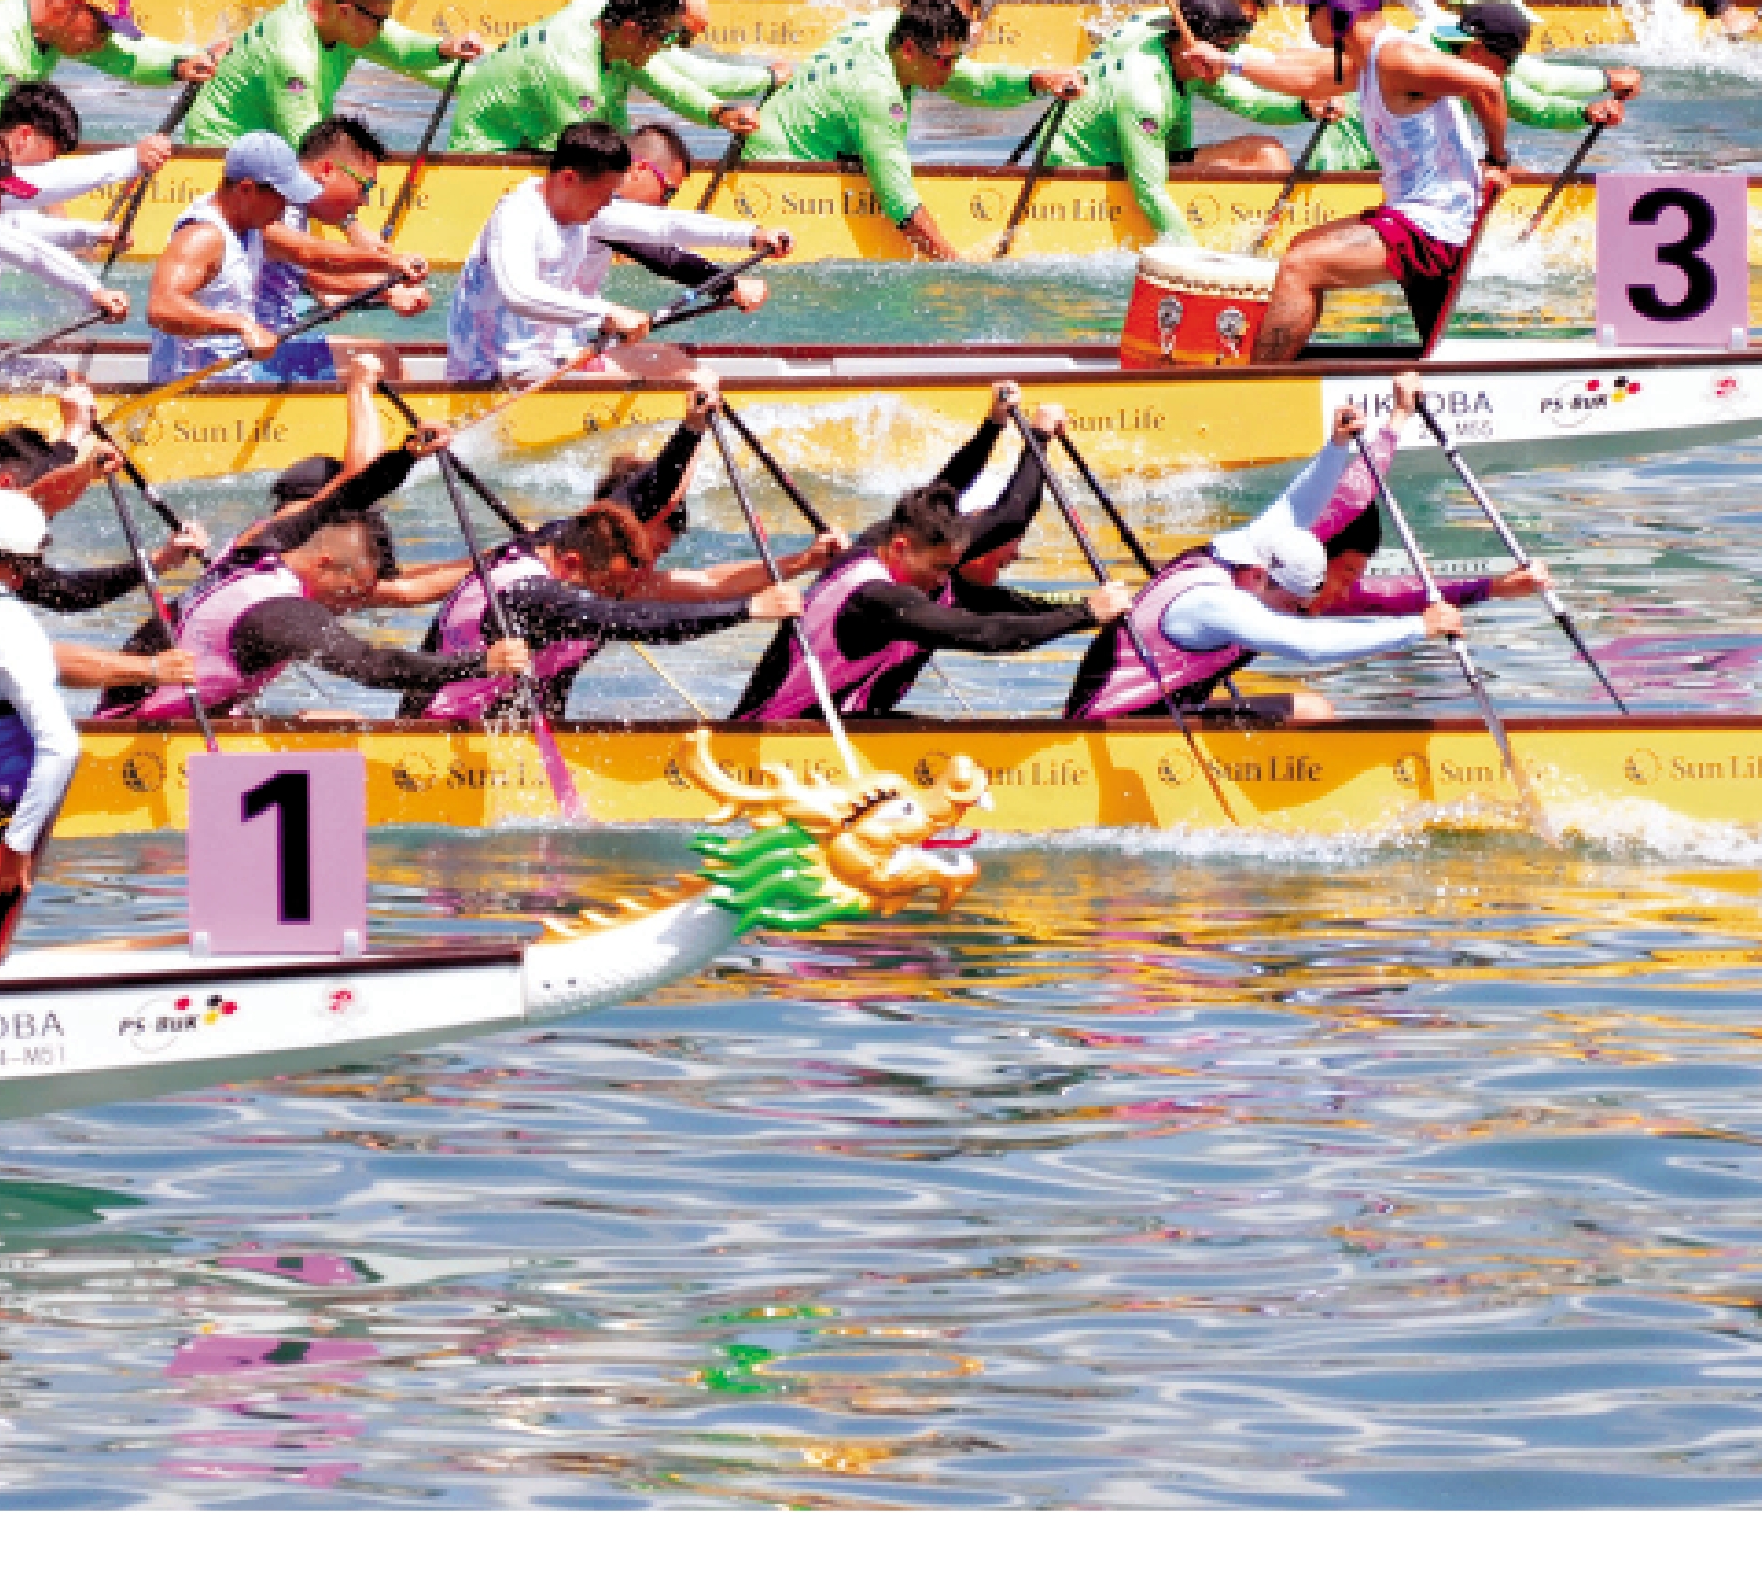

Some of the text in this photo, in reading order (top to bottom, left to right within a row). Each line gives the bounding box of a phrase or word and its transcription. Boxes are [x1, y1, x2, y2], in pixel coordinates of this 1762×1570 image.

[781, 193, 835, 215] Sun
[1626, 188, 1717, 321] 3
[1117, 404, 1166, 431] Life
[172, 419, 288, 443] Sun Life
[1031, 761, 1089, 786] Life
[1268, 757, 1324, 782] Life
[1440, 759, 1494, 783] Sun
[1669, 756, 1725, 780] Sun
[241, 770, 312, 925] 1
